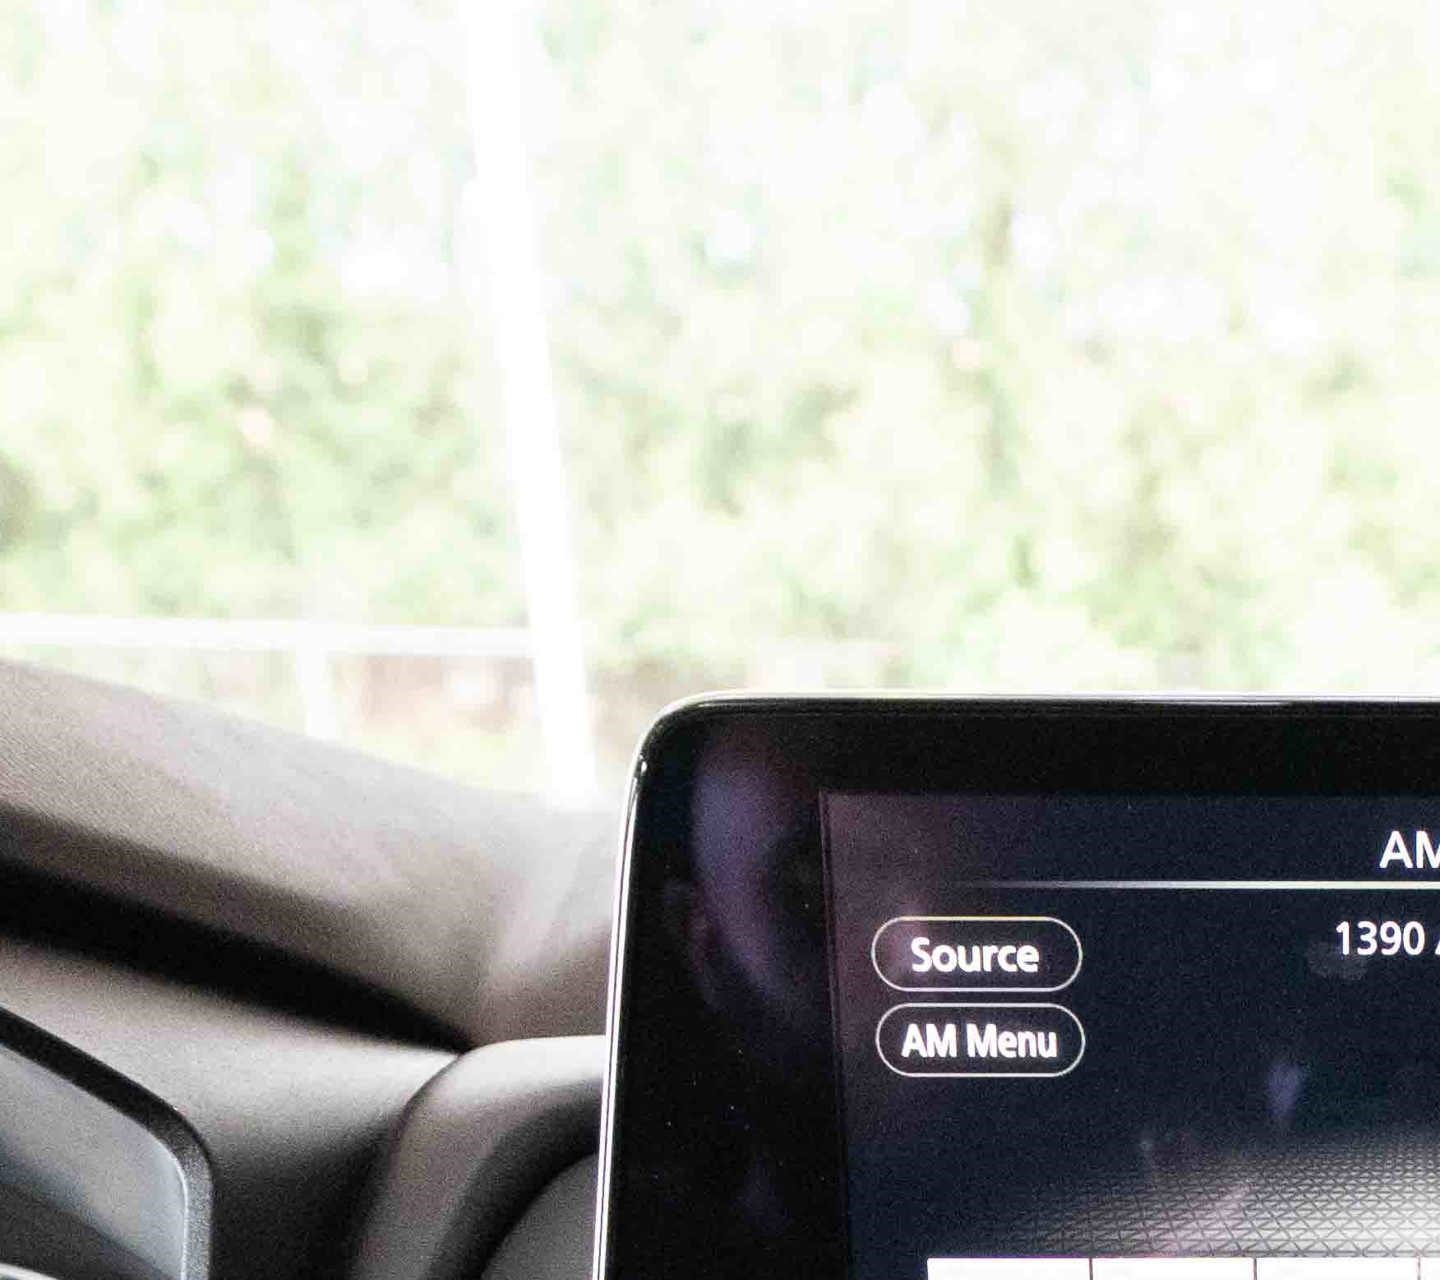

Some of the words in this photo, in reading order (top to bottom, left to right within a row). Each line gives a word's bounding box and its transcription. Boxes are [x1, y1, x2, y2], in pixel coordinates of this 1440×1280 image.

[911, 938, 1039, 972] Source
[1335, 921, 1425, 955] 1390
[902, 1024, 957, 1058] AM
[967, 1024, 1057, 1058] Menu
